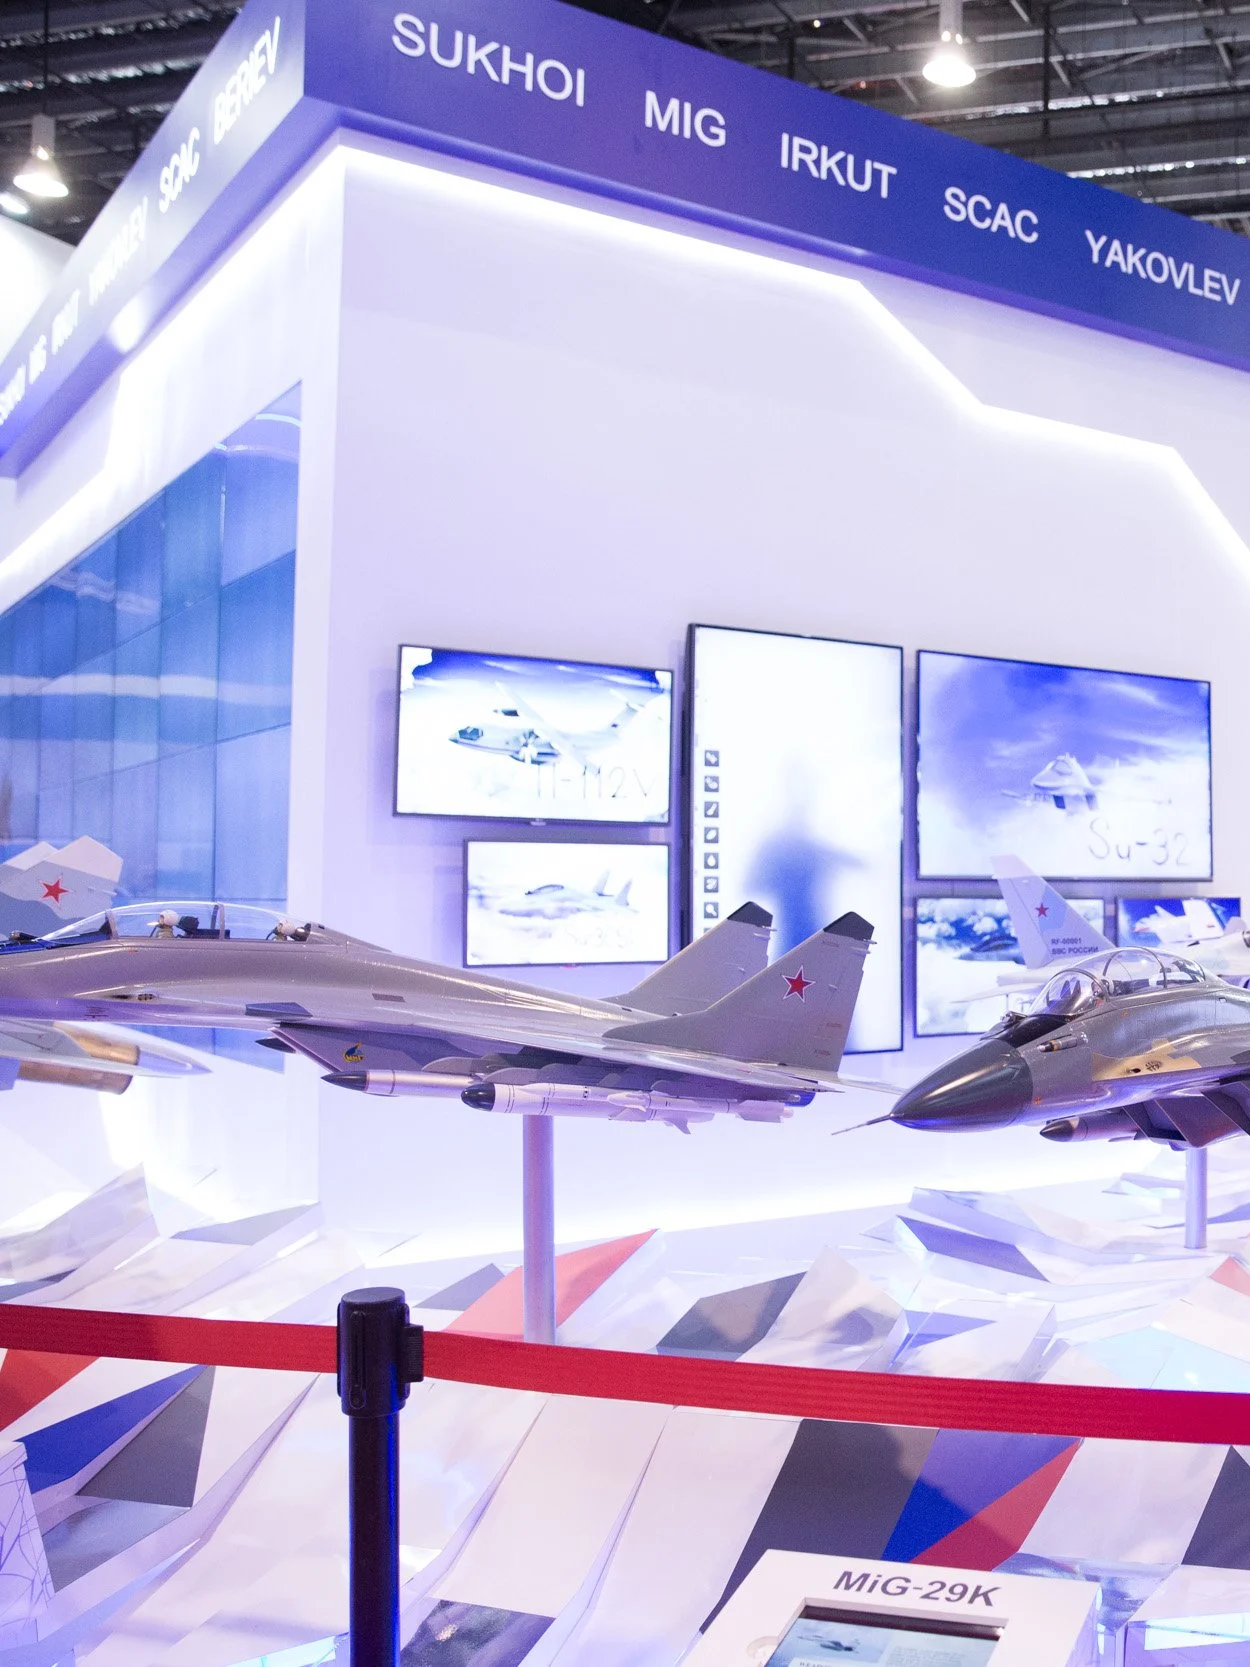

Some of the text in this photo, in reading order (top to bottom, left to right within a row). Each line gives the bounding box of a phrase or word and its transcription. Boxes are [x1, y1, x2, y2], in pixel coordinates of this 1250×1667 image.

[158, 126, 201, 214] SCAC
[213, 15, 281, 145] BERIEV
[392, 12, 585, 107] SUKHOI
[644, 90, 727, 147] MIG
[780, 132, 898, 199] IRKUT
[943, 186, 1039, 243] SCAC
[1085, 229, 1241, 305] YAKOVLEV
[1088, 816, 1190, 867] Su-32
[832, 1570, 1001, 1608] MiG-29K
